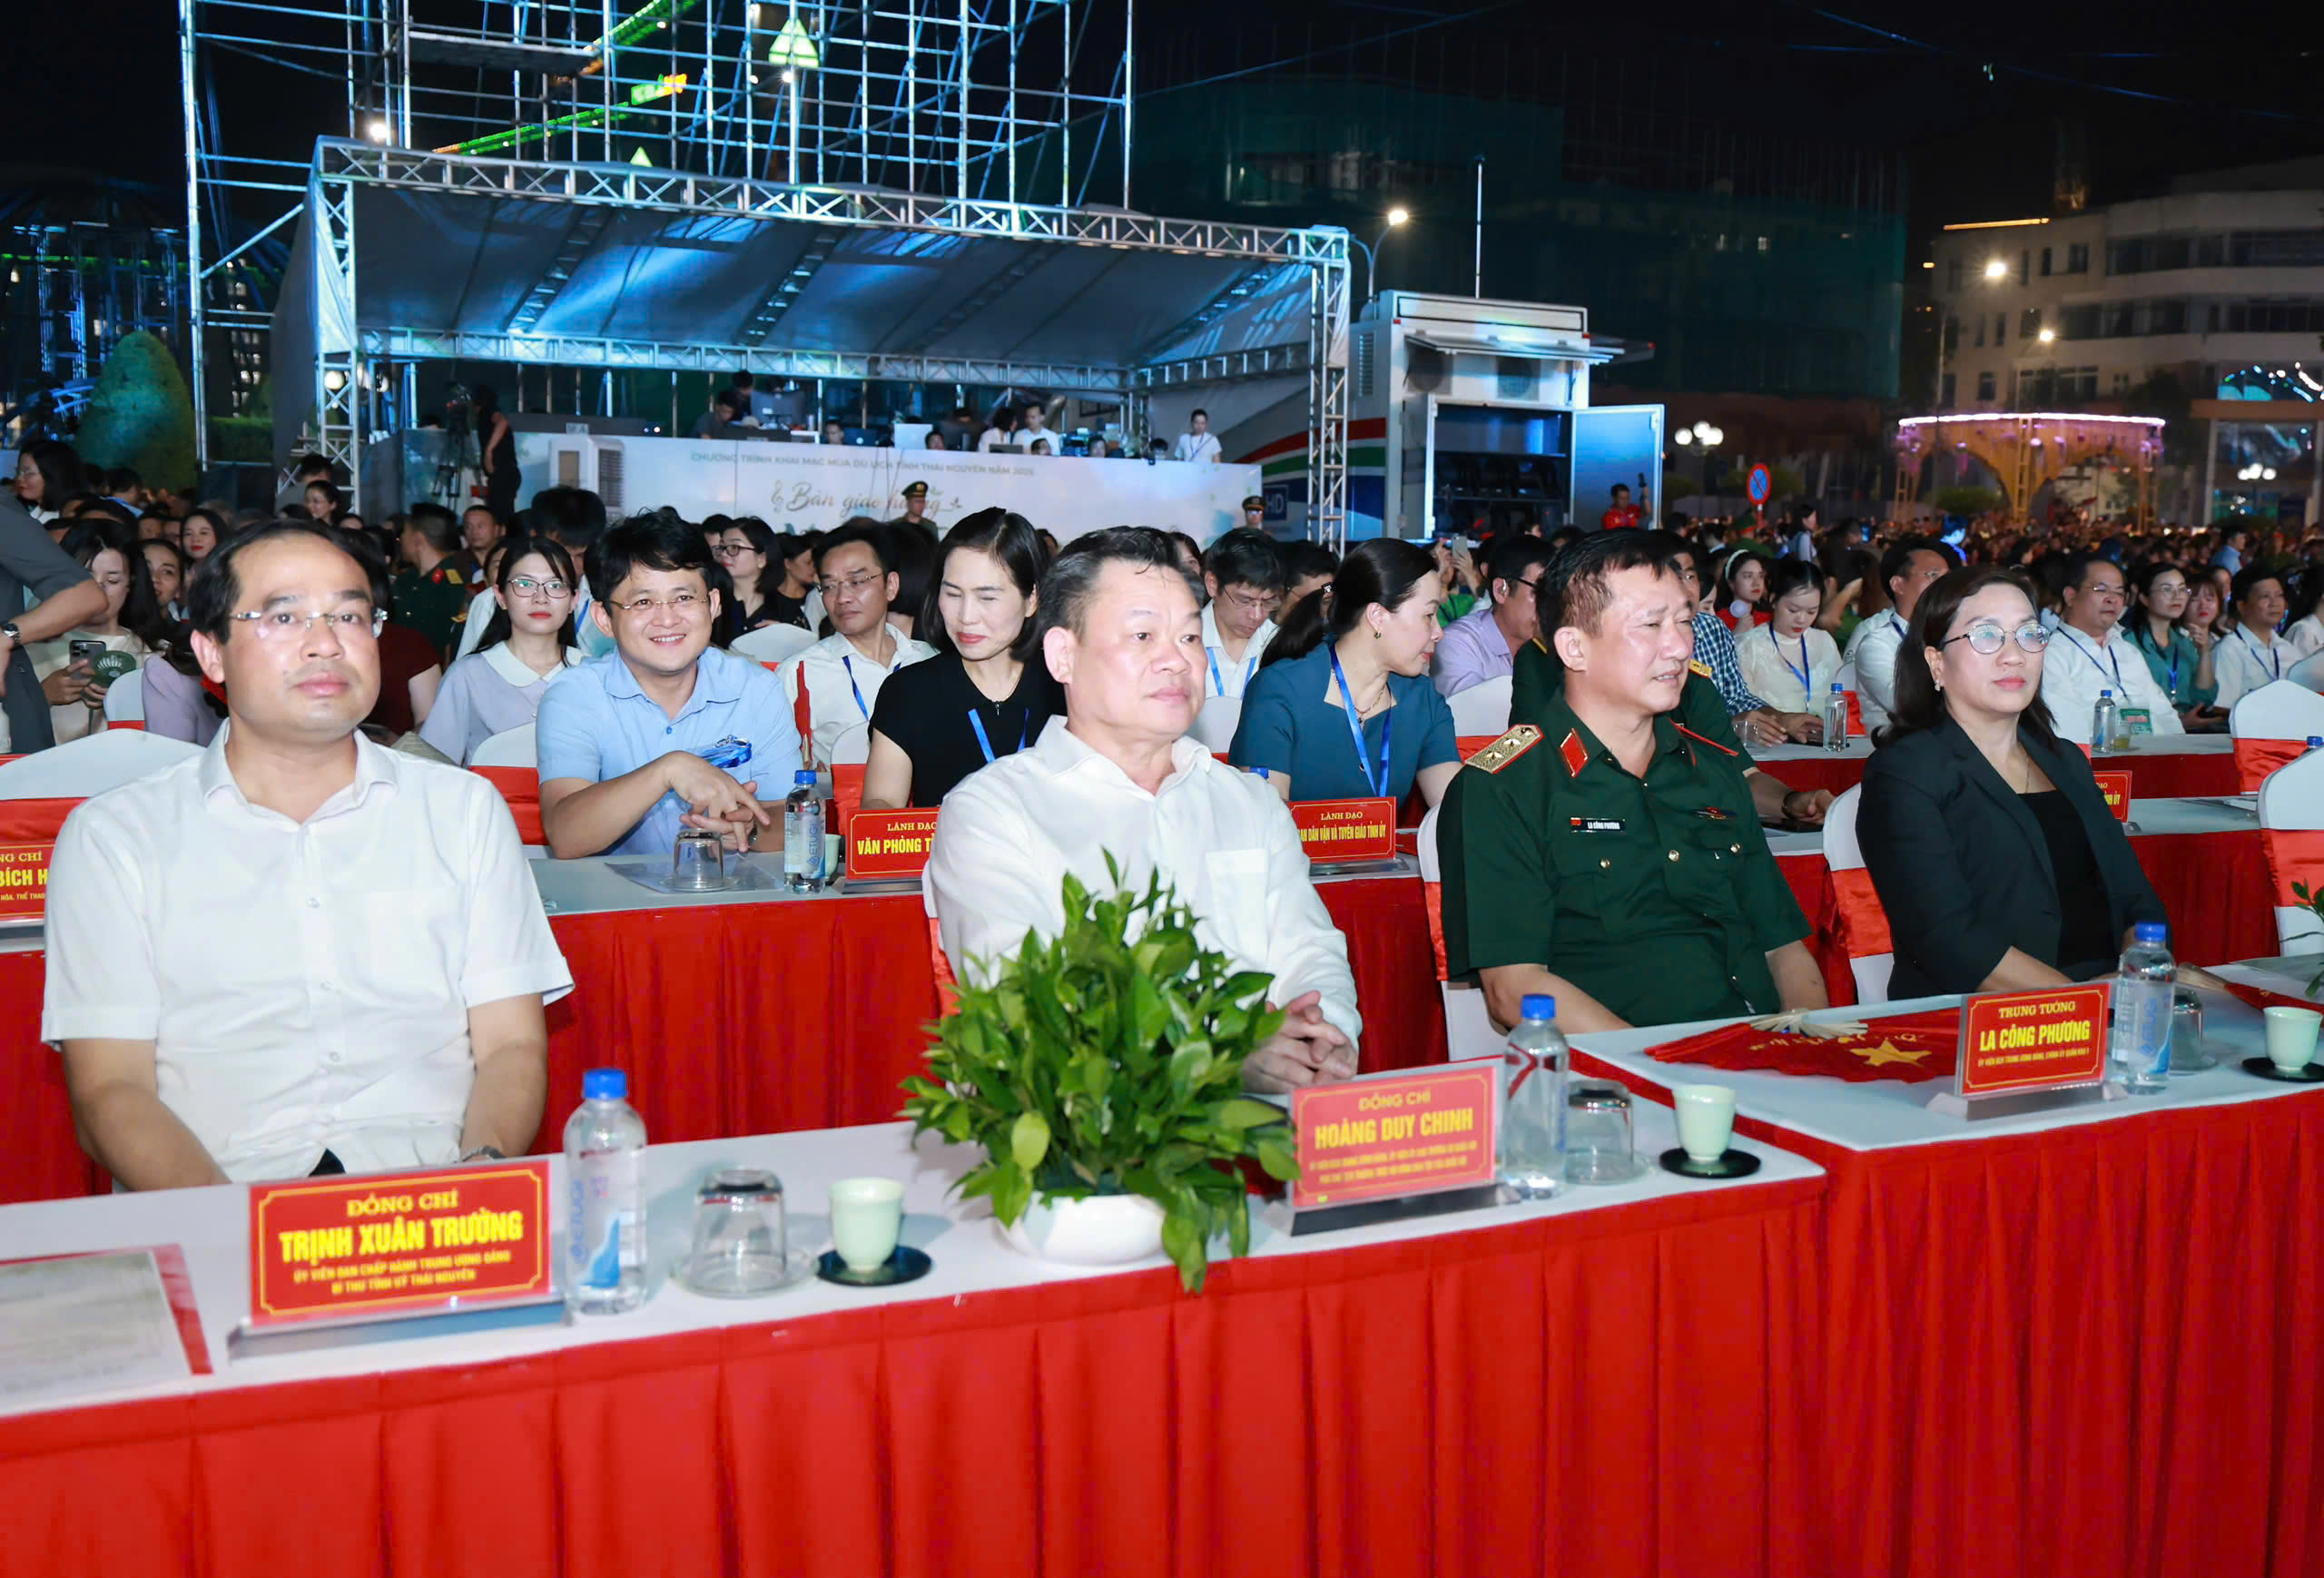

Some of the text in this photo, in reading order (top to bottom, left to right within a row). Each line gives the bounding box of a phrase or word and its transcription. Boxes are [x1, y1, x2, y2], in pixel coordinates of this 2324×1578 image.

[775, 456, 799, 465] KHAI
[857, 837, 881, 854] VĂN
[883, 834, 922, 854] PHÒNG
[18, 850, 44, 862] CHÍ
[1998, 1004, 2036, 1019] TRUNG
[1980, 1030, 1995, 1051] LA
[1999, 1023, 2035, 1050] CÔNG
[2038, 1020, 2091, 1045] PHƯƠNG
[1405, 1087, 1431, 1105] CHÍ
[1315, 1106, 1473, 1150] HOÀNG DUY CHINH
[347, 1188, 458, 1217] ĐỒNG CHÍ
[280, 1207, 524, 1267] TRỊNH XUÂN TRƯỜNG
